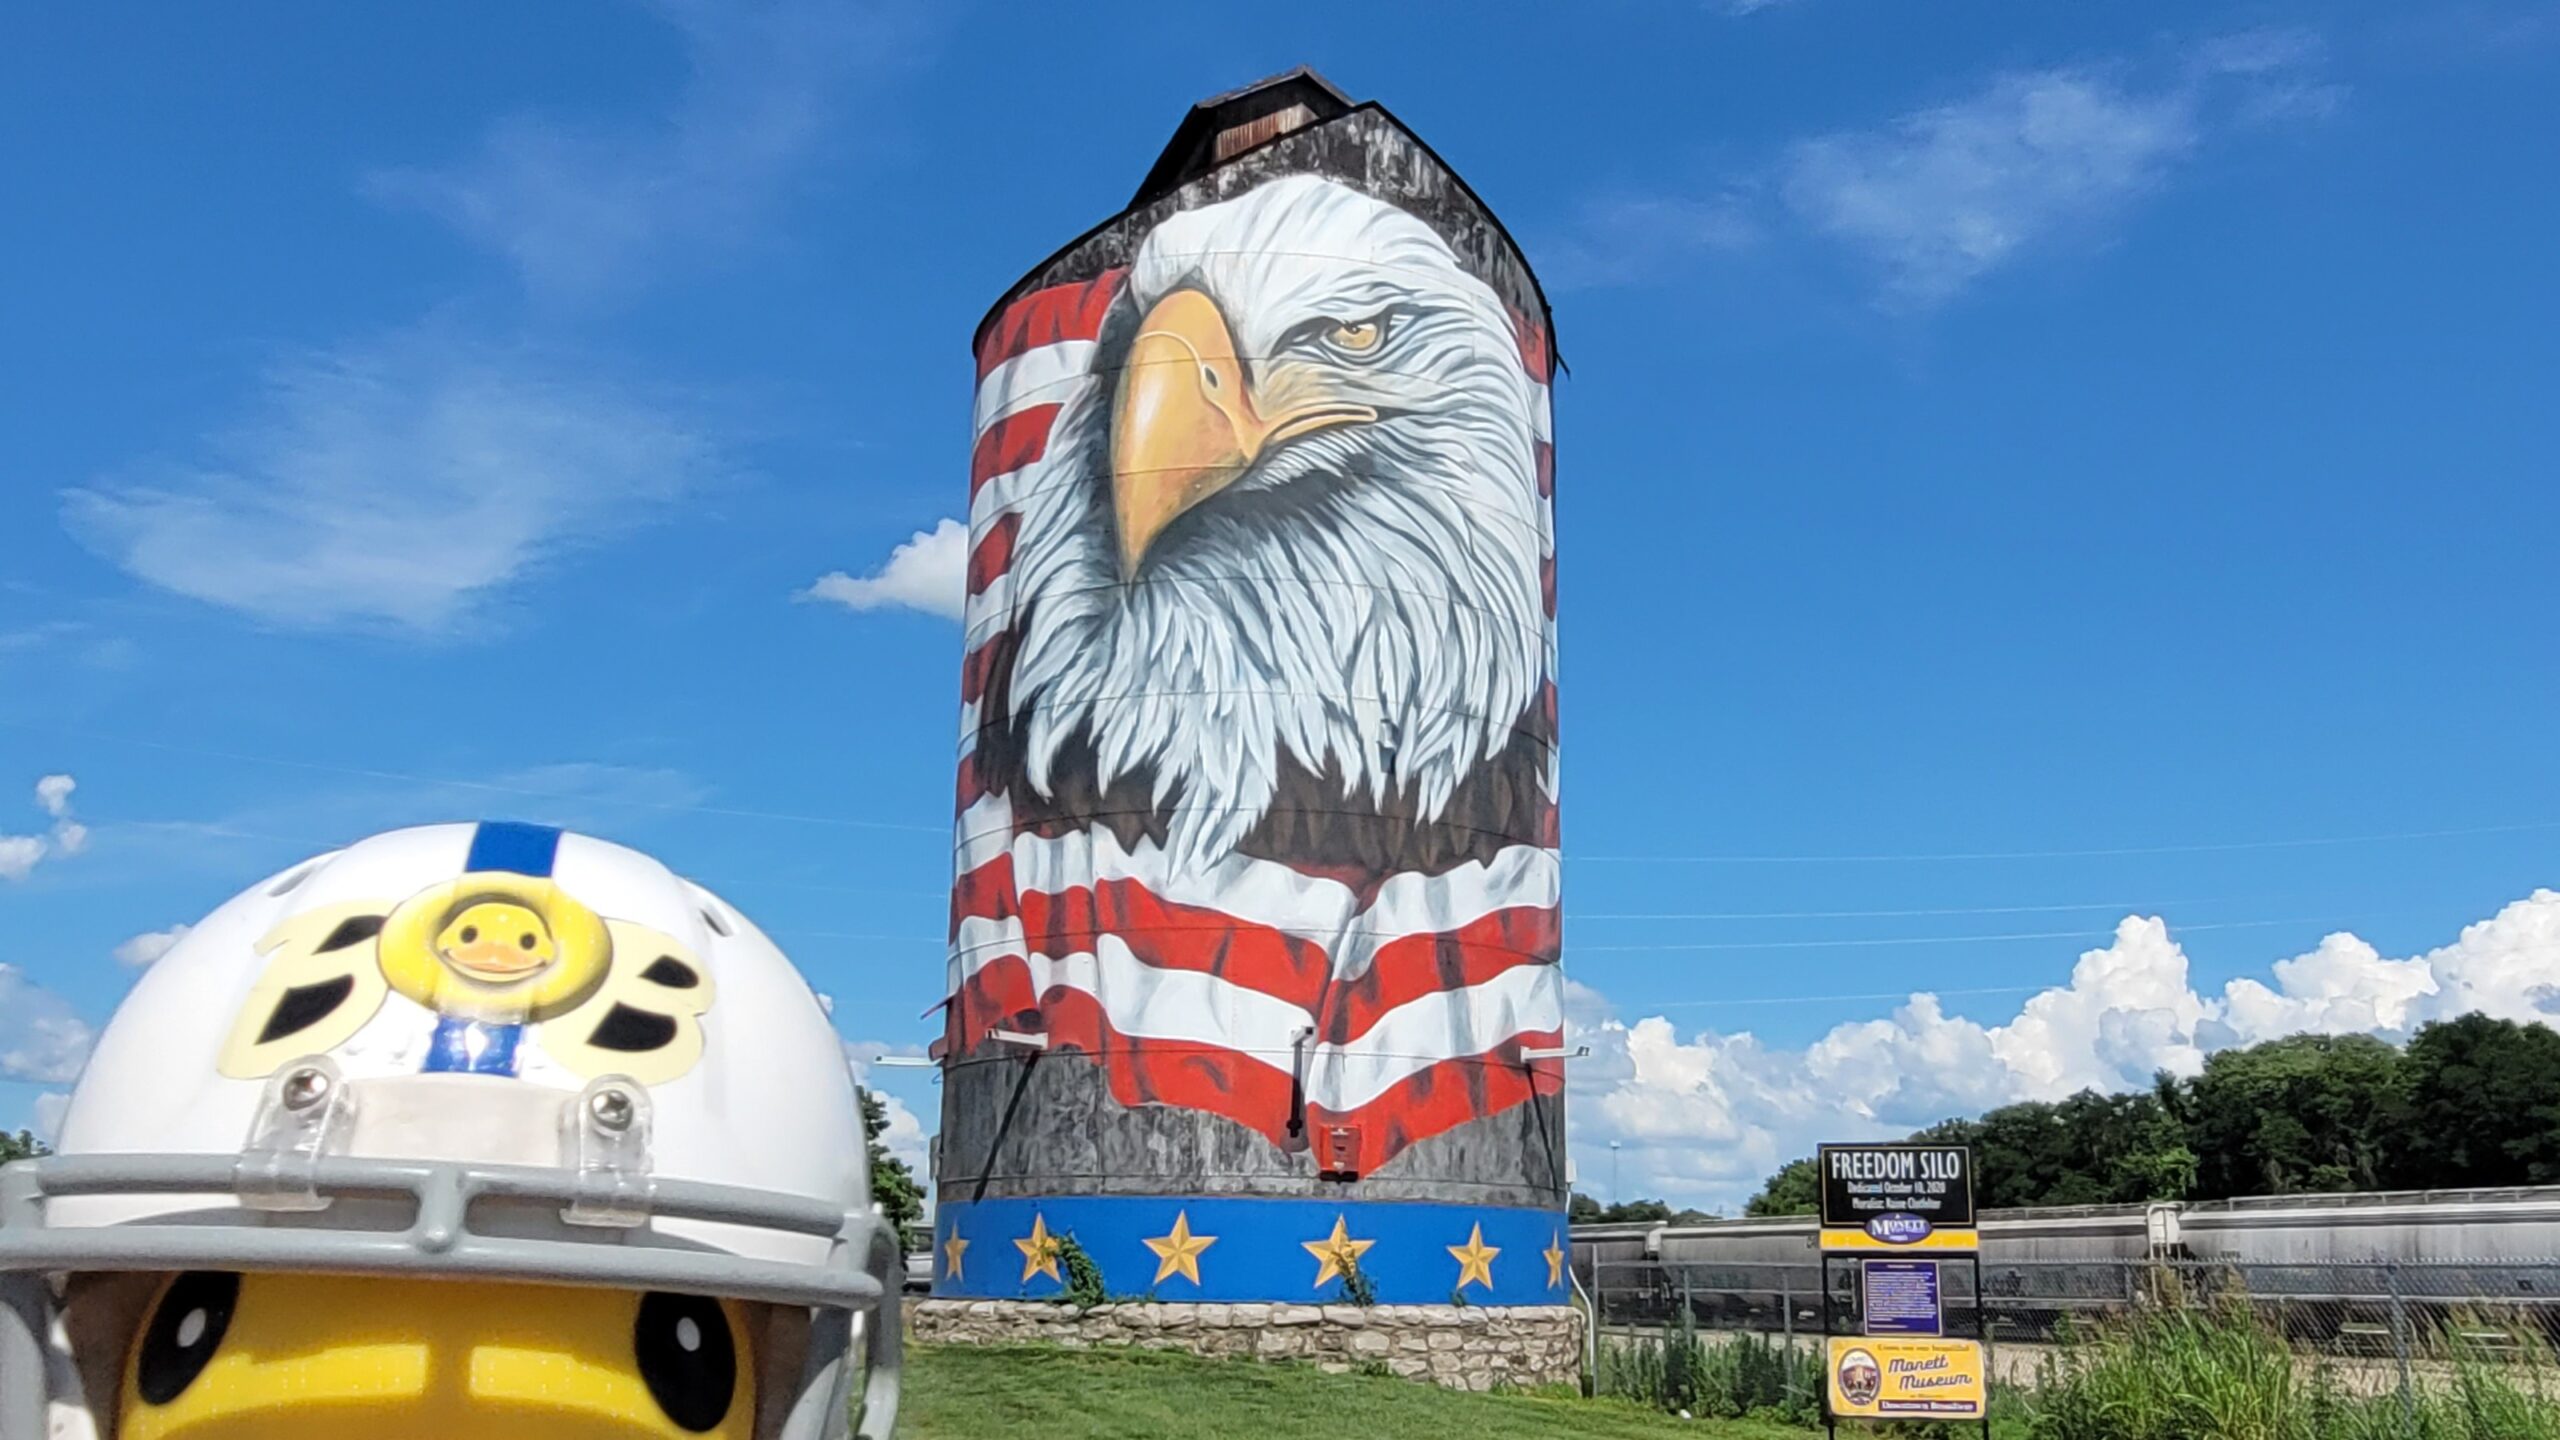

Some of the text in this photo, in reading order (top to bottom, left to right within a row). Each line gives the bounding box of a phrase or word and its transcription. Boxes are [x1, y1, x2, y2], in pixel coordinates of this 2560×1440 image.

[1831, 1151, 1960, 1180] FREEDOM SILO
[1888, 1354, 1949, 1374] Monett
[1899, 1374, 1973, 1391] Museum
